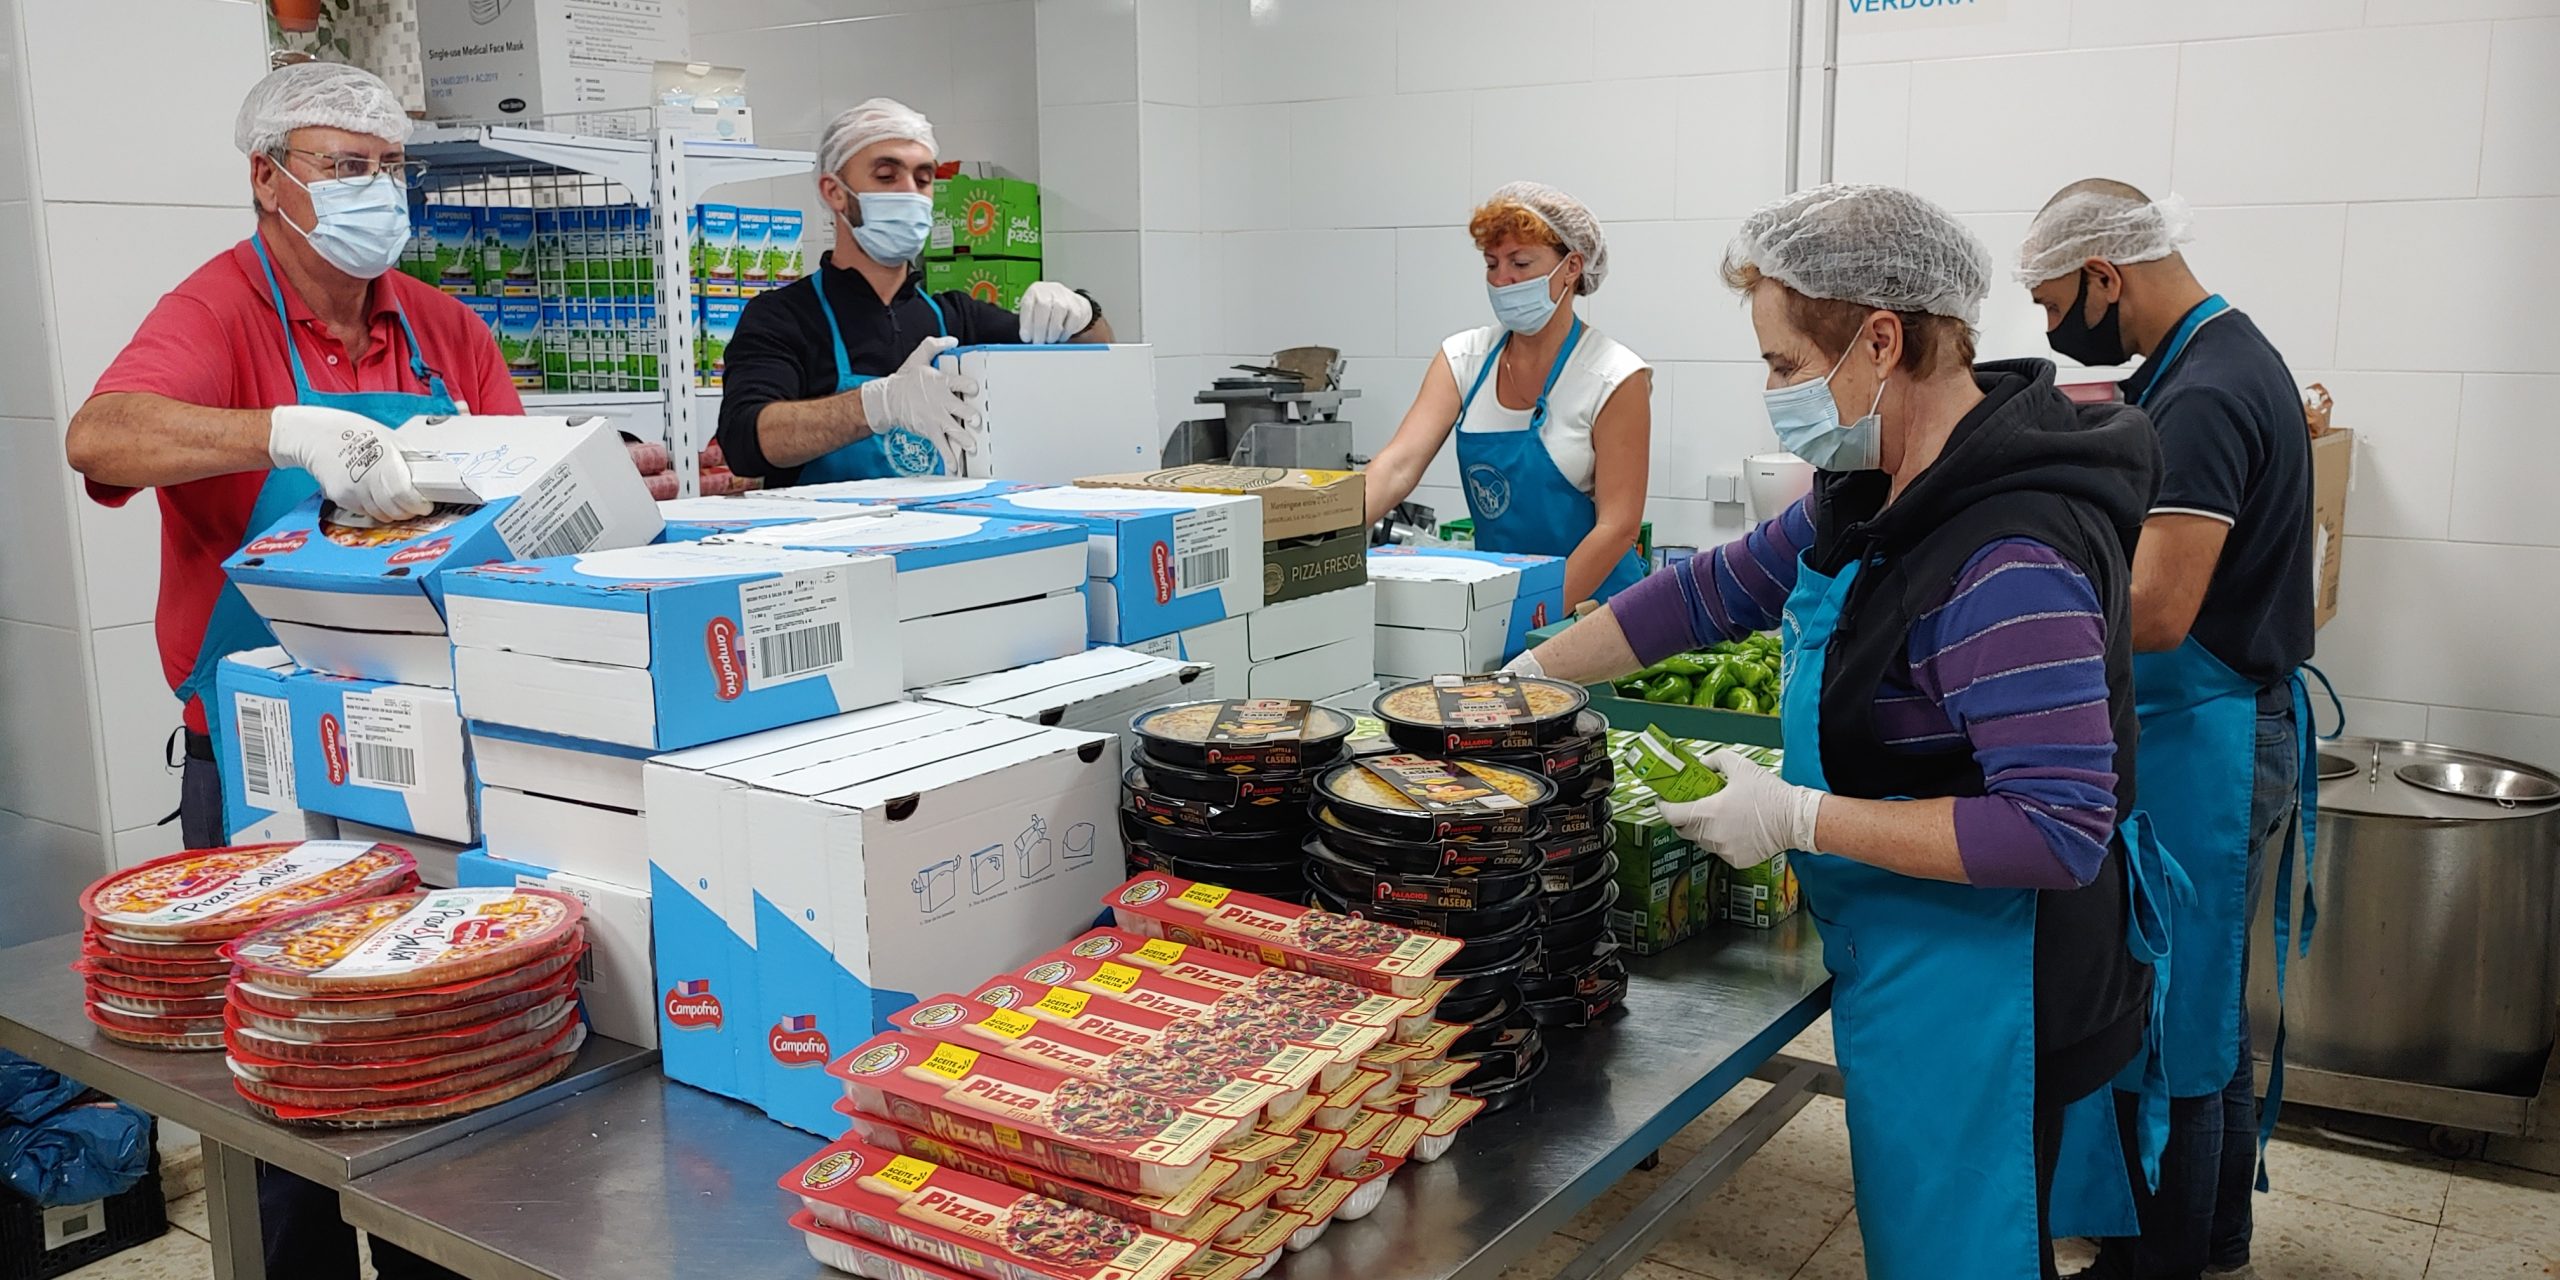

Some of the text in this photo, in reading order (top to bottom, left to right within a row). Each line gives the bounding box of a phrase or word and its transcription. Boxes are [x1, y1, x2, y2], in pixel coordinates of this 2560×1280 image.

[428, 40, 524, 61] Single-use Medical Face Mask
[1292, 552, 1364, 582] PIZZA FRESCA
[1502, 738, 1533, 748] CASERA
[1265, 755, 1297, 764] CASERA
[1583, 749, 1605, 763] CASERA
[1491, 825, 1524, 833] CASERA
[1561, 822, 1590, 833] CASERA
[1578, 841, 1602, 855] CASERA
[1494, 856, 1523, 864] CASERA
[173, 891, 229, 913] Pizza
[234, 863, 304, 887] Salsa
[1546, 882, 1570, 891] ASERA
[1189, 890, 1211, 899] ACEITE
[1194, 895, 1213, 904] OLIVA
[1391, 891, 1428, 900] PALACIOS
[1437, 897, 1472, 908] CASERA
[1219, 907, 1288, 933] Pizza
[1258, 930, 1287, 944] Fina
[387, 934, 445, 962] Salsa
[1144, 948, 1168, 958] ACEITE
[1201, 936, 1260, 964] Pizza
[1148, 953, 1168, 962] OLIVA
[1102, 967, 1118, 976] CON
[1174, 965, 1244, 989] Pizza
[1092, 976, 1123, 988] DE OLIVA
[1097, 973, 1122, 983] ACEITE
[1046, 998, 1070, 1009] ACEITE
[1050, 1004, 1072, 1014] OLIVA
[1130, 992, 1202, 1018] Pizza
[984, 1021, 1016, 1035] DE OLIVA
[990, 1019, 1015, 1030] ACEITE
[1078, 1018, 1152, 1045] Pizza
[937, 1049, 952, 1059] CON
[1020, 1039, 1096, 1068] Pizza
[932, 1056, 958, 1067] ACEITE
[937, 1064, 958, 1075] OLIVA
[963, 1079, 1042, 1110] Pizza
[1005, 1107, 1036, 1123] Fina
[930, 1111, 994, 1148] Pizza
[893, 1160, 908, 1170] CON
[887, 1167, 914, 1179] ACEITE
[891, 1176, 914, 1186] OLIVA
[917, 1191, 996, 1227] Pizza
[959, 1224, 990, 1240] Fina
